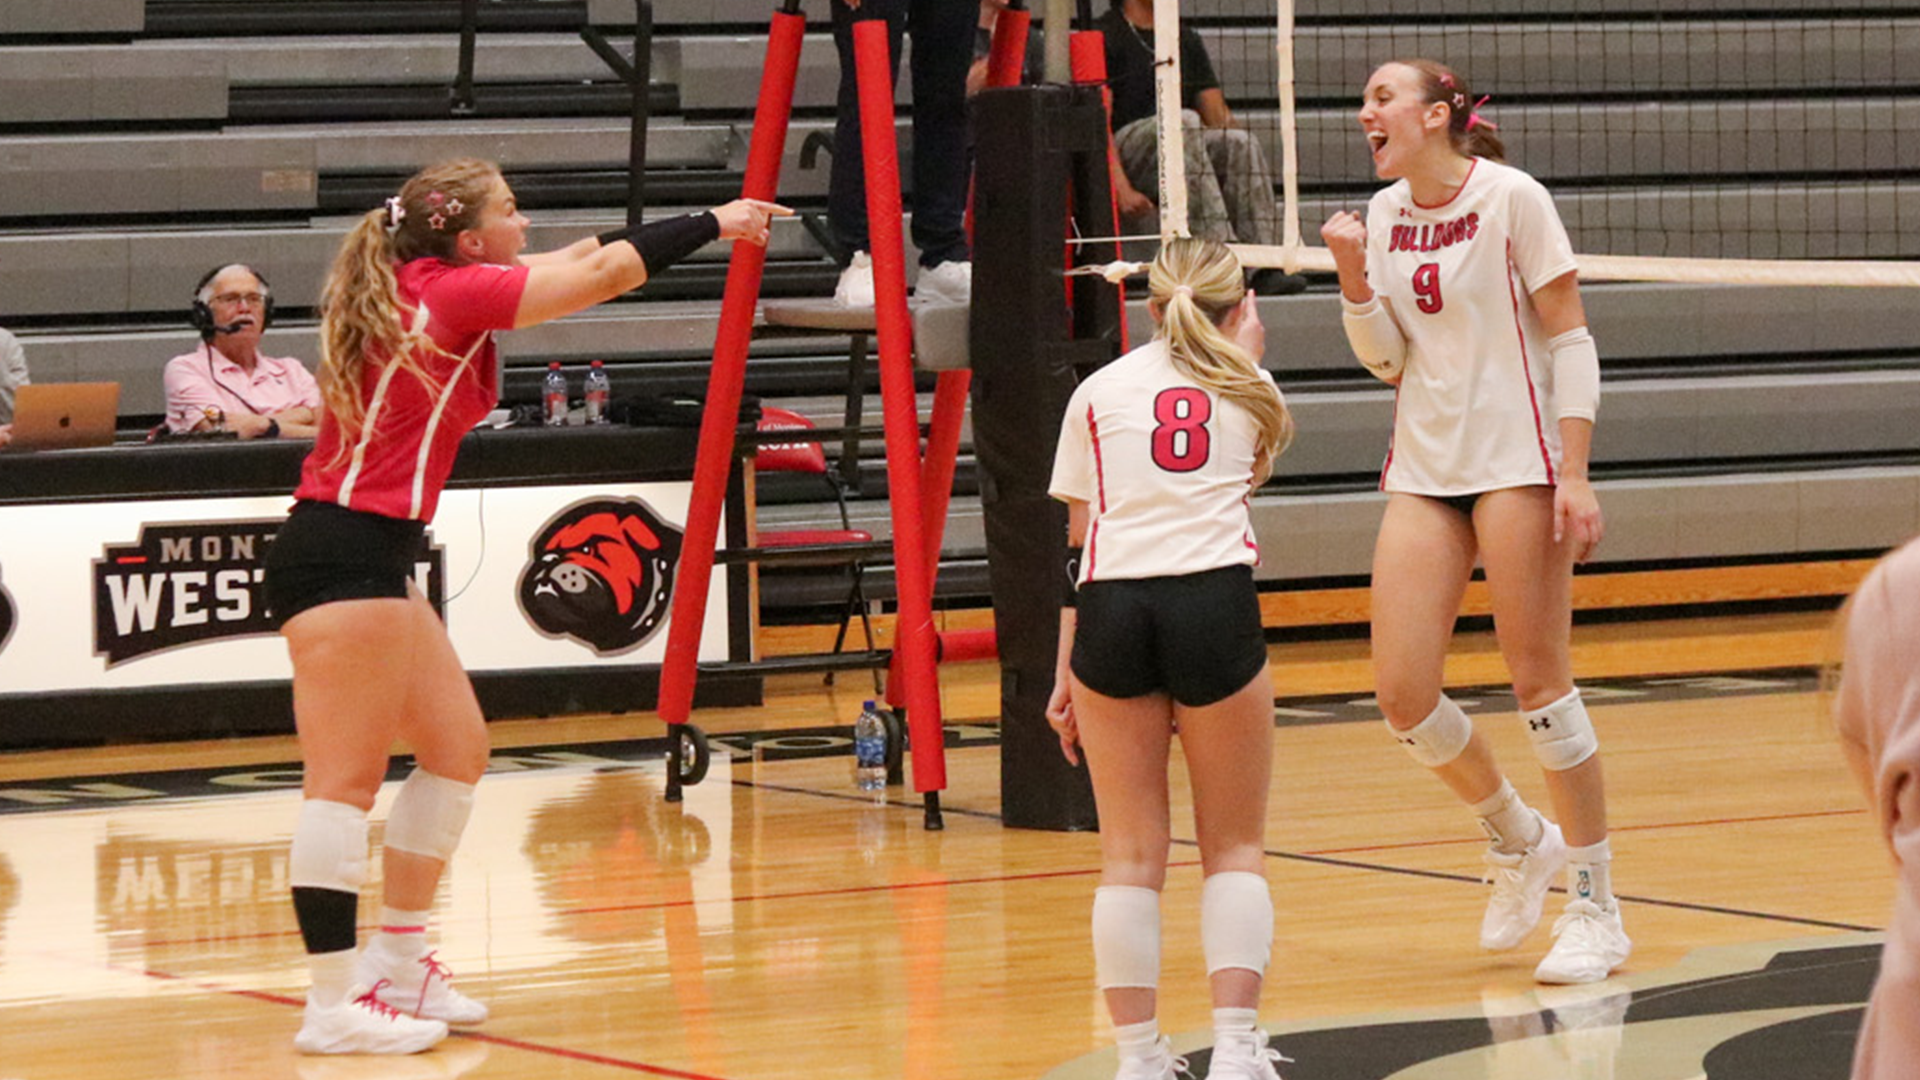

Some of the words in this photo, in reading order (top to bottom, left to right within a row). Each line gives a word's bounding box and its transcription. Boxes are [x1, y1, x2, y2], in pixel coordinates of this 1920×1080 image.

[1388, 212, 1479, 252] BULLDOGS
[1412, 262, 1443, 314] 9
[1151, 386, 1211, 473] 8
